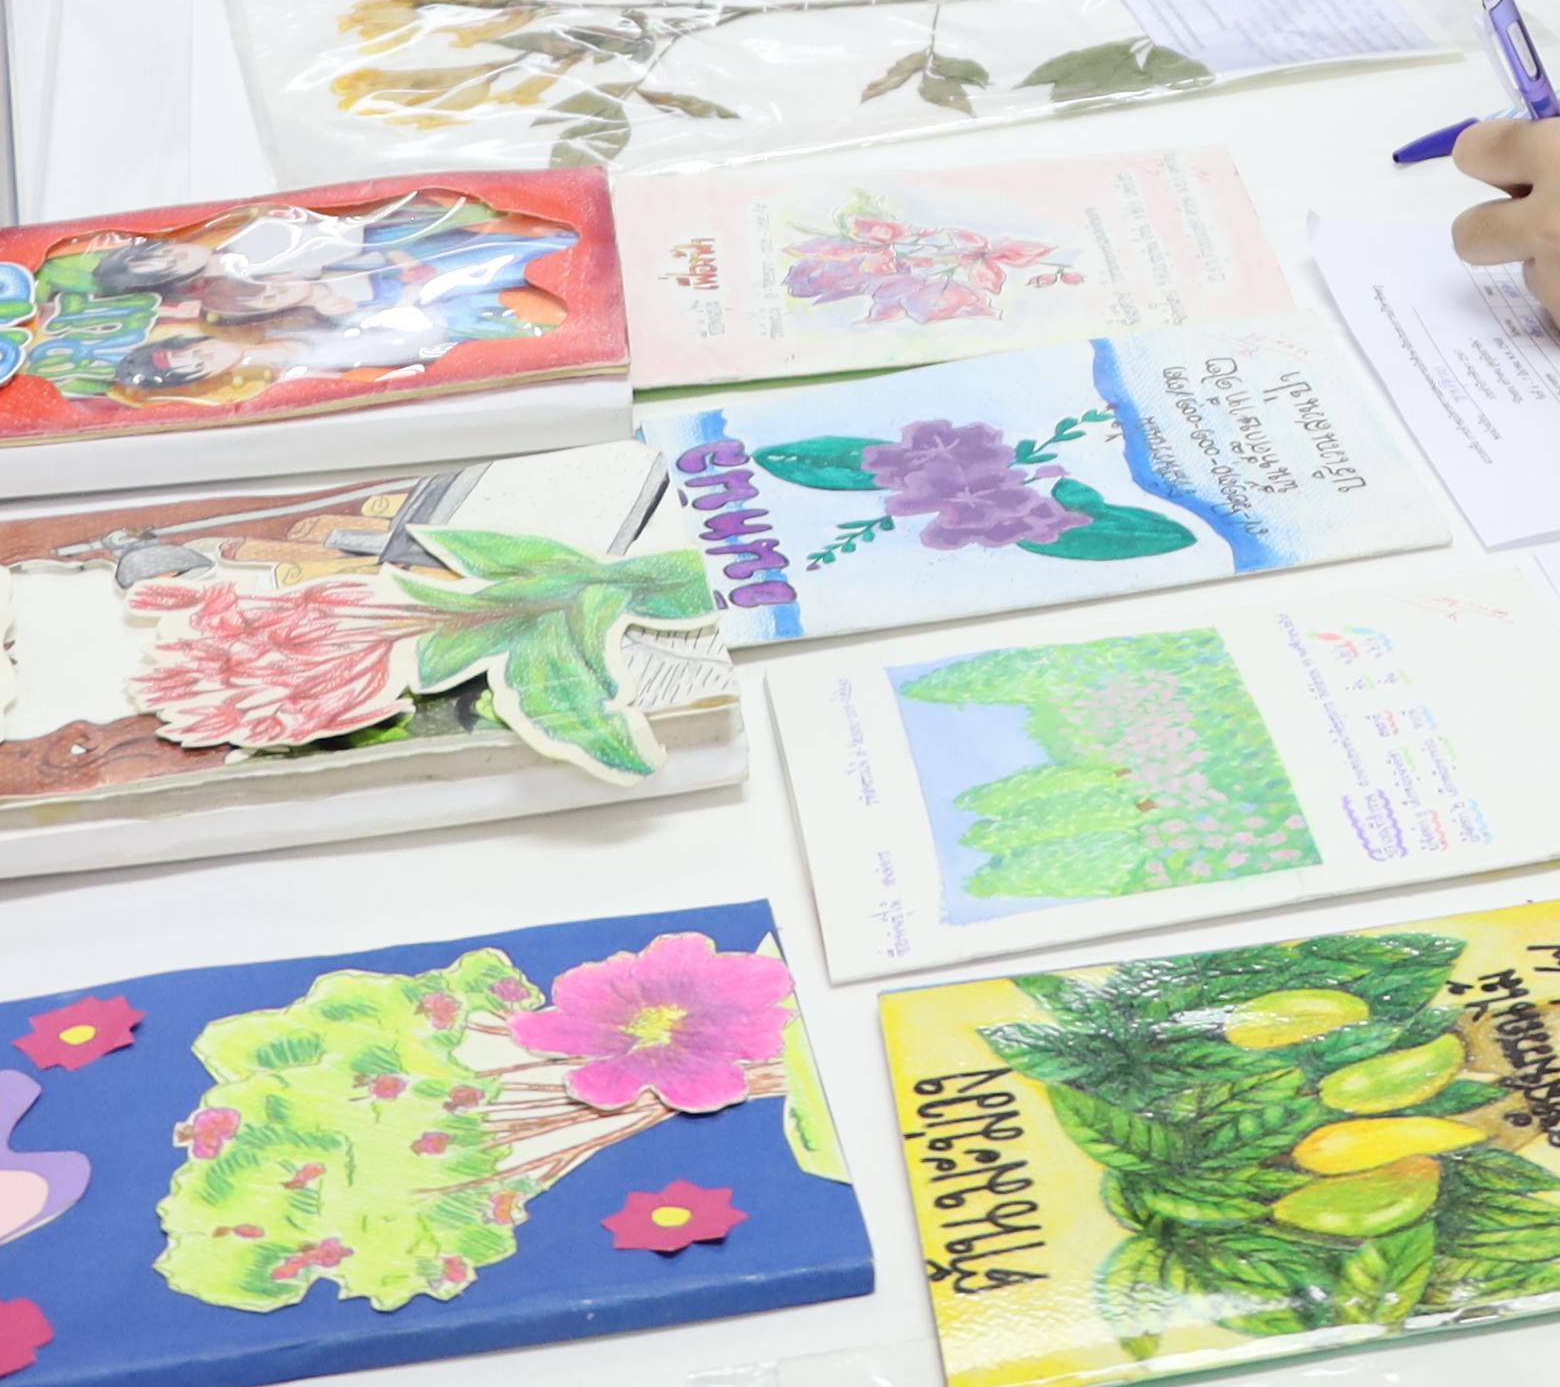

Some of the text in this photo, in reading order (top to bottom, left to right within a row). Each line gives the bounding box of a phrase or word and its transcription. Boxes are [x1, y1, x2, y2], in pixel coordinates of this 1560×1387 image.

[657, 237, 722, 291] เฟื่องฟ้า
[674, 437, 796, 611] อินทนิล
[906, 1065, 1052, 1295] ต้นมะม่วง
